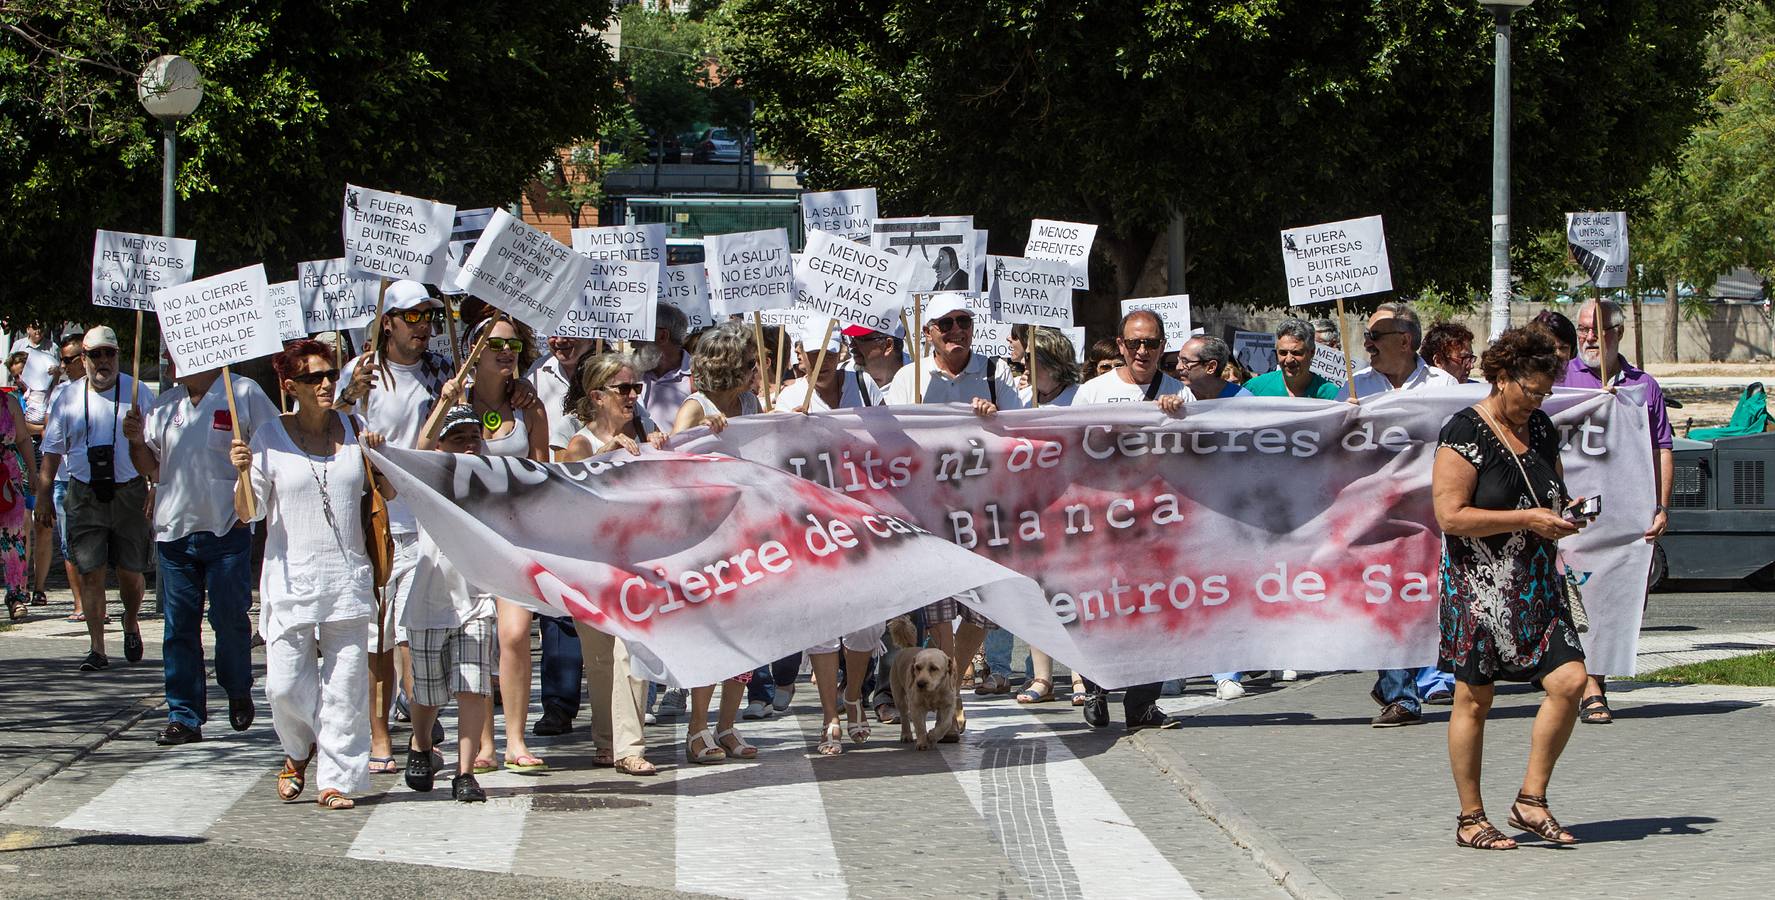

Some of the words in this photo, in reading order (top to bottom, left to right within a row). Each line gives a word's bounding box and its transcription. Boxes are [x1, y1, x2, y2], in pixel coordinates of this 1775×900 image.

[369, 198, 414, 217] FUERA
[805, 208, 820, 219] LA
[822, 204, 862, 218] SALUT
[354, 210, 426, 235] EMPRESAS
[824, 220, 841, 231] ÉS
[844, 218, 870, 230] UNA
[1582, 217, 1592, 226] SE
[1592, 216, 1610, 226] HACE
[361, 226, 411, 246] BUITRE
[508, 222, 525, 236] NO
[524, 230, 540, 246] SE
[540, 238, 570, 262] HACE
[590, 232, 646, 246] MENOS
[1038, 226, 1079, 240] MENOS
[1305, 230, 1347, 244] FUERA
[1580, 228, 1590, 237] UN
[122, 238, 167, 252] MENYS
[356, 240, 373, 254] LA
[376, 245, 434, 266] SANIDAD
[512, 238, 529, 252] UN
[1028, 240, 1085, 256] GERENTES
[1296, 240, 1363, 260] EMPRESAS
[102, 250, 184, 269] RETALLADES
[354, 255, 410, 276] PÚBLICA
[497, 246, 555, 284] DIFERENTE
[722, 252, 740, 266] LA
[742, 248, 783, 264] SALUT
[828, 242, 889, 272] MENOS
[1308, 255, 1352, 272] BUITRE
[133, 267, 161, 281] MÉS
[303, 272, 374, 288] RECOR
[504, 272, 527, 288] CON
[721, 270, 740, 282] NO
[744, 266, 761, 281] ÉS
[764, 264, 792, 279] UNA
[808, 256, 898, 296] GERENTES
[994, 268, 1066, 288] RECORTAR
[1290, 276, 1305, 288] DE
[1308, 274, 1324, 286] LA
[1325, 265, 1379, 283] SANIDAD
[111, 281, 168, 295] QUALIT
[163, 298, 182, 312] NO
[184, 294, 200, 307] AL
[201, 280, 249, 302] CIERRE
[322, 289, 356, 304] PARA
[465, 264, 498, 286] GENTE
[496, 281, 556, 320] INDIFERENTE
[824, 280, 834, 294] Y
[836, 286, 873, 307] MÁS
[1014, 287, 1049, 301] PARA
[1310, 282, 1362, 299] PÚBLICA
[592, 294, 622, 308] MÉS
[798, 290, 892, 330] SANITARIOS
[994, 301, 1070, 320] PRIVATIZAR
[165, 313, 183, 327] DE
[186, 307, 206, 322] 200
[209, 295, 254, 316] CAMAS
[305, 304, 377, 322] PRIVATIZAR
[567, 310, 634, 324] QUALITAT
[166, 330, 182, 343] EN
[184, 325, 200, 338] EL
[202, 308, 262, 333] HOSPITAL
[176, 332, 236, 356] GENERAL
[238, 326, 256, 340] DE
[188, 344, 248, 368] ALICANTE
[936, 438, 989, 481] ni
[1006, 438, 1062, 474] de
[1083, 424, 1320, 460] Centres
[1340, 422, 1412, 453] de
[948, 493, 1184, 550] Blanca
[619, 540, 793, 622] Cierre
[804, 514, 859, 558] de
[1049, 574, 1230, 625] entros
[1255, 561, 1326, 602] de
